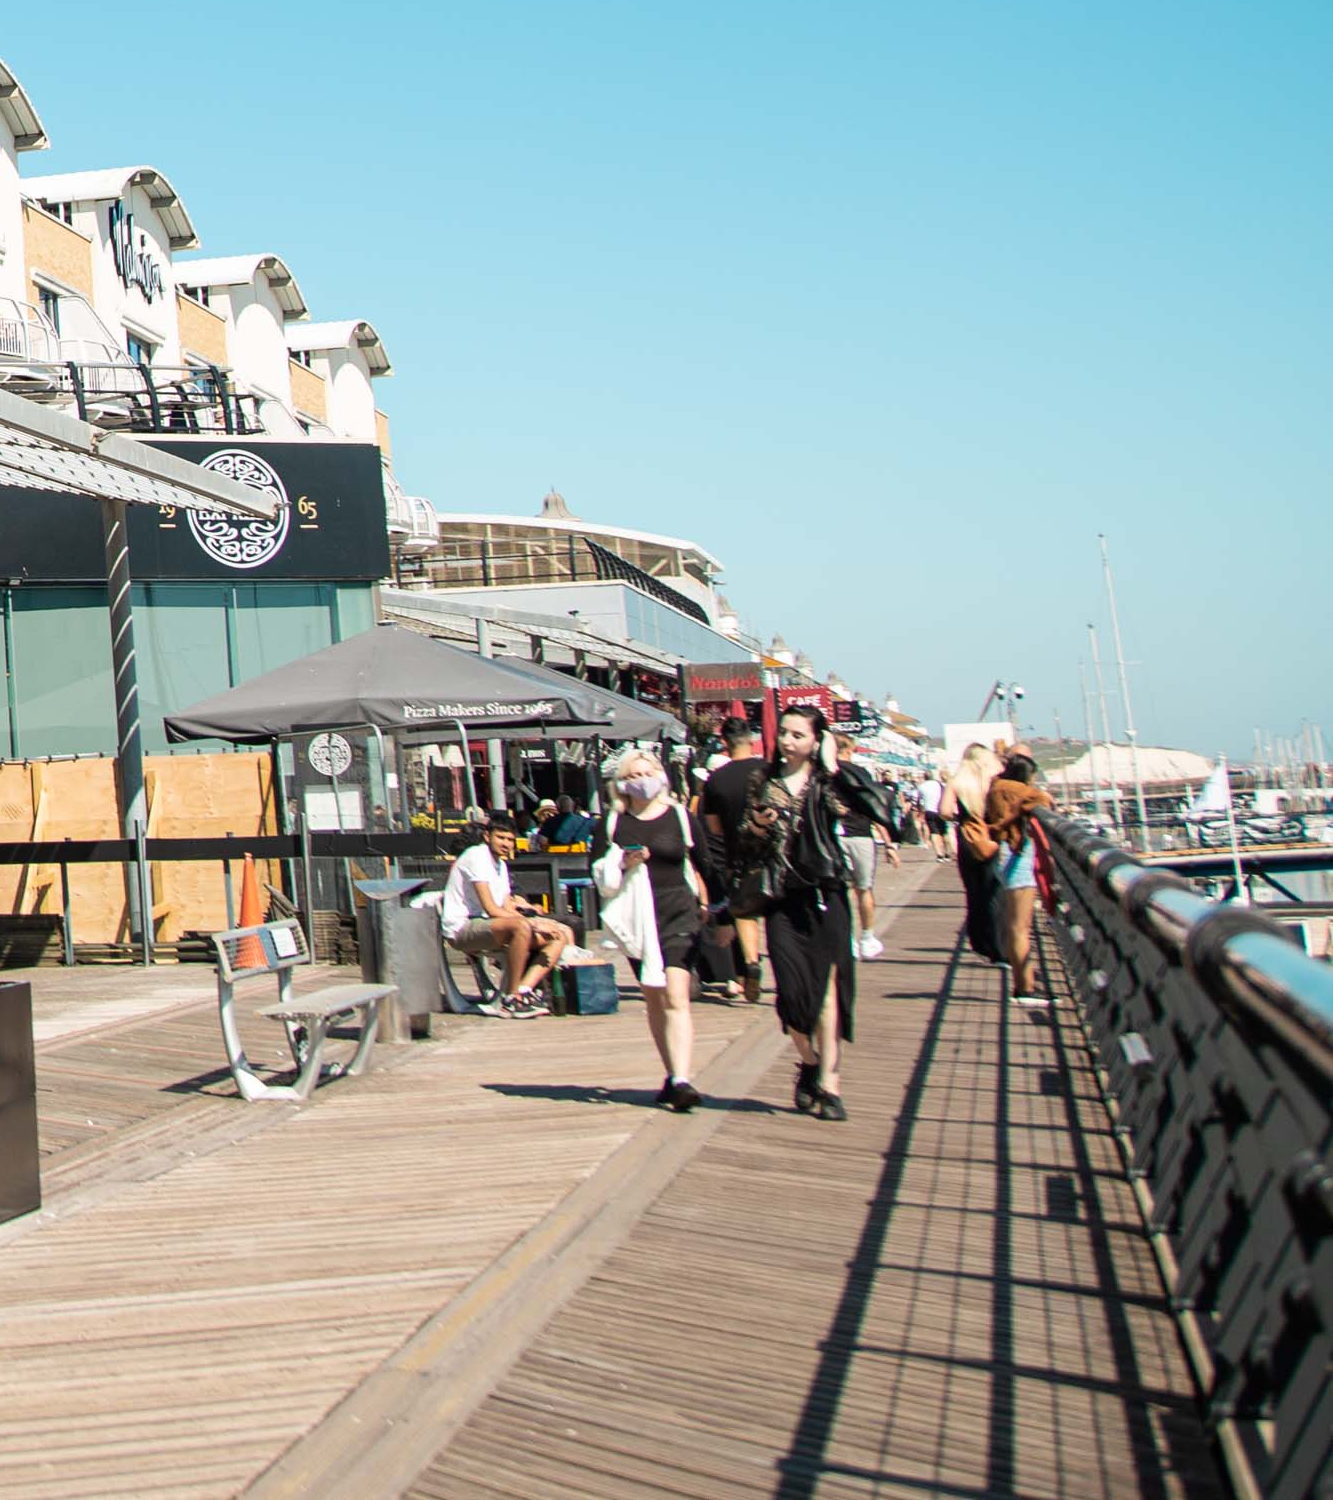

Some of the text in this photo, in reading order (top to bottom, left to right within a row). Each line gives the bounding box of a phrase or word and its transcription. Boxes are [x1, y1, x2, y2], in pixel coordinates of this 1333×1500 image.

[298, 496, 317, 519] 65
[688, 671, 761, 692] Nando's
[403, 705, 436, 718] Pizza
[438, 703, 485, 717] Makers
[487, 703, 522, 716] Since
